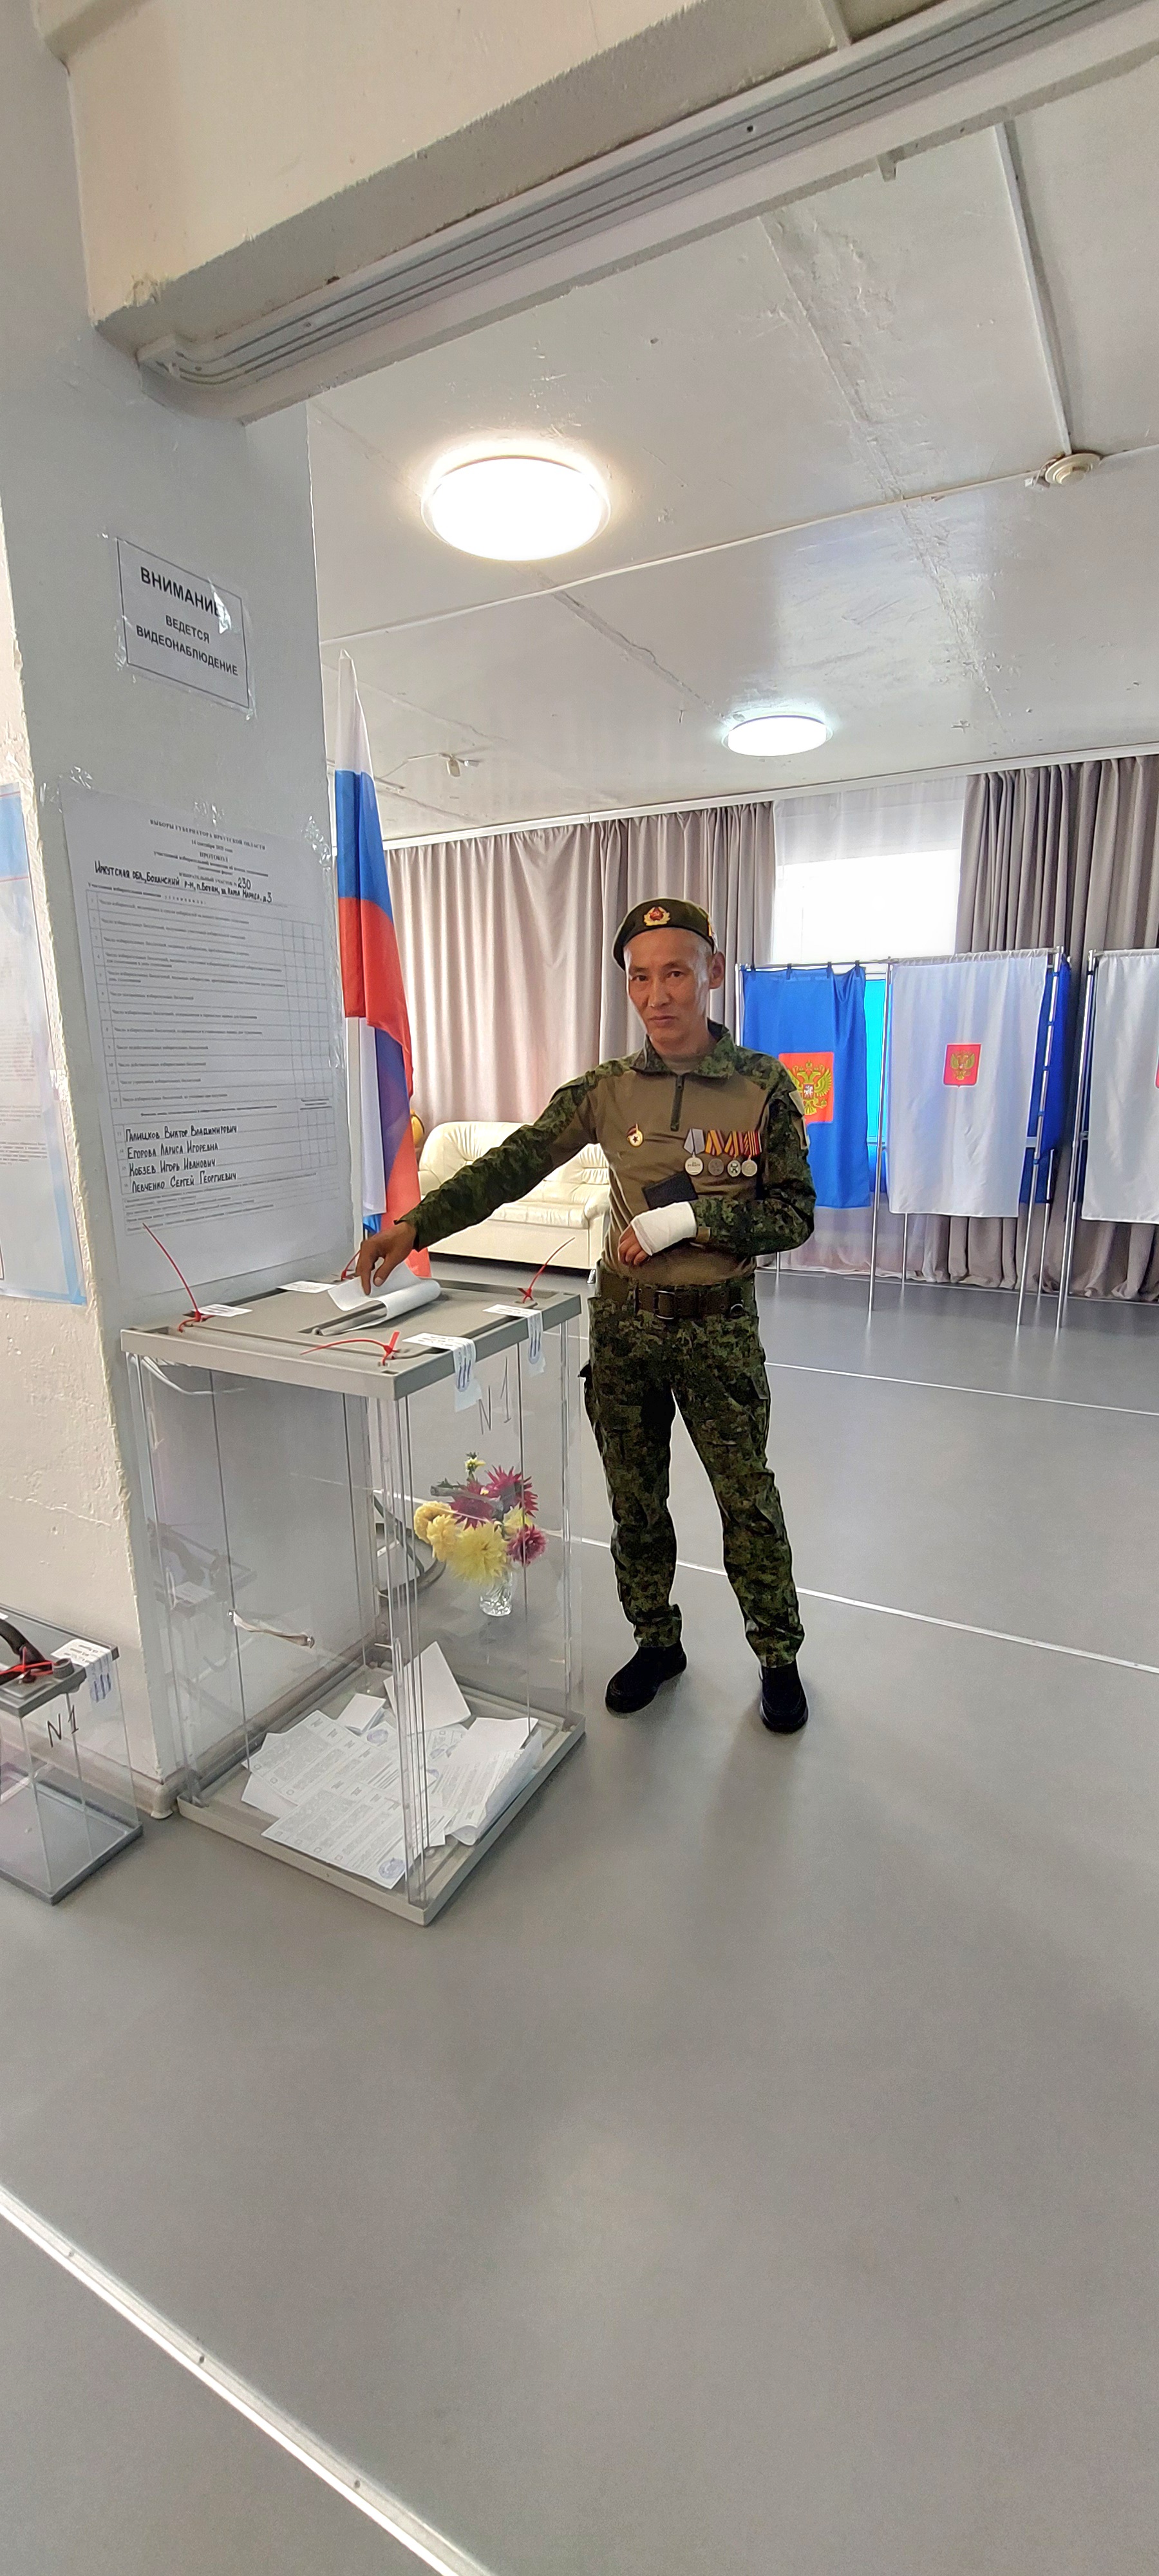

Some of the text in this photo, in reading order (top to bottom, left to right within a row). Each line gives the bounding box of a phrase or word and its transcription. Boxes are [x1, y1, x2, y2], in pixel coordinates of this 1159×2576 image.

[165, 614, 210, 644] ВЕДЕТСЯ
[136, 625, 238, 676] ВИДЕОНАБЛЮДЕНИЕ
[237, 876, 252, 890] 230
